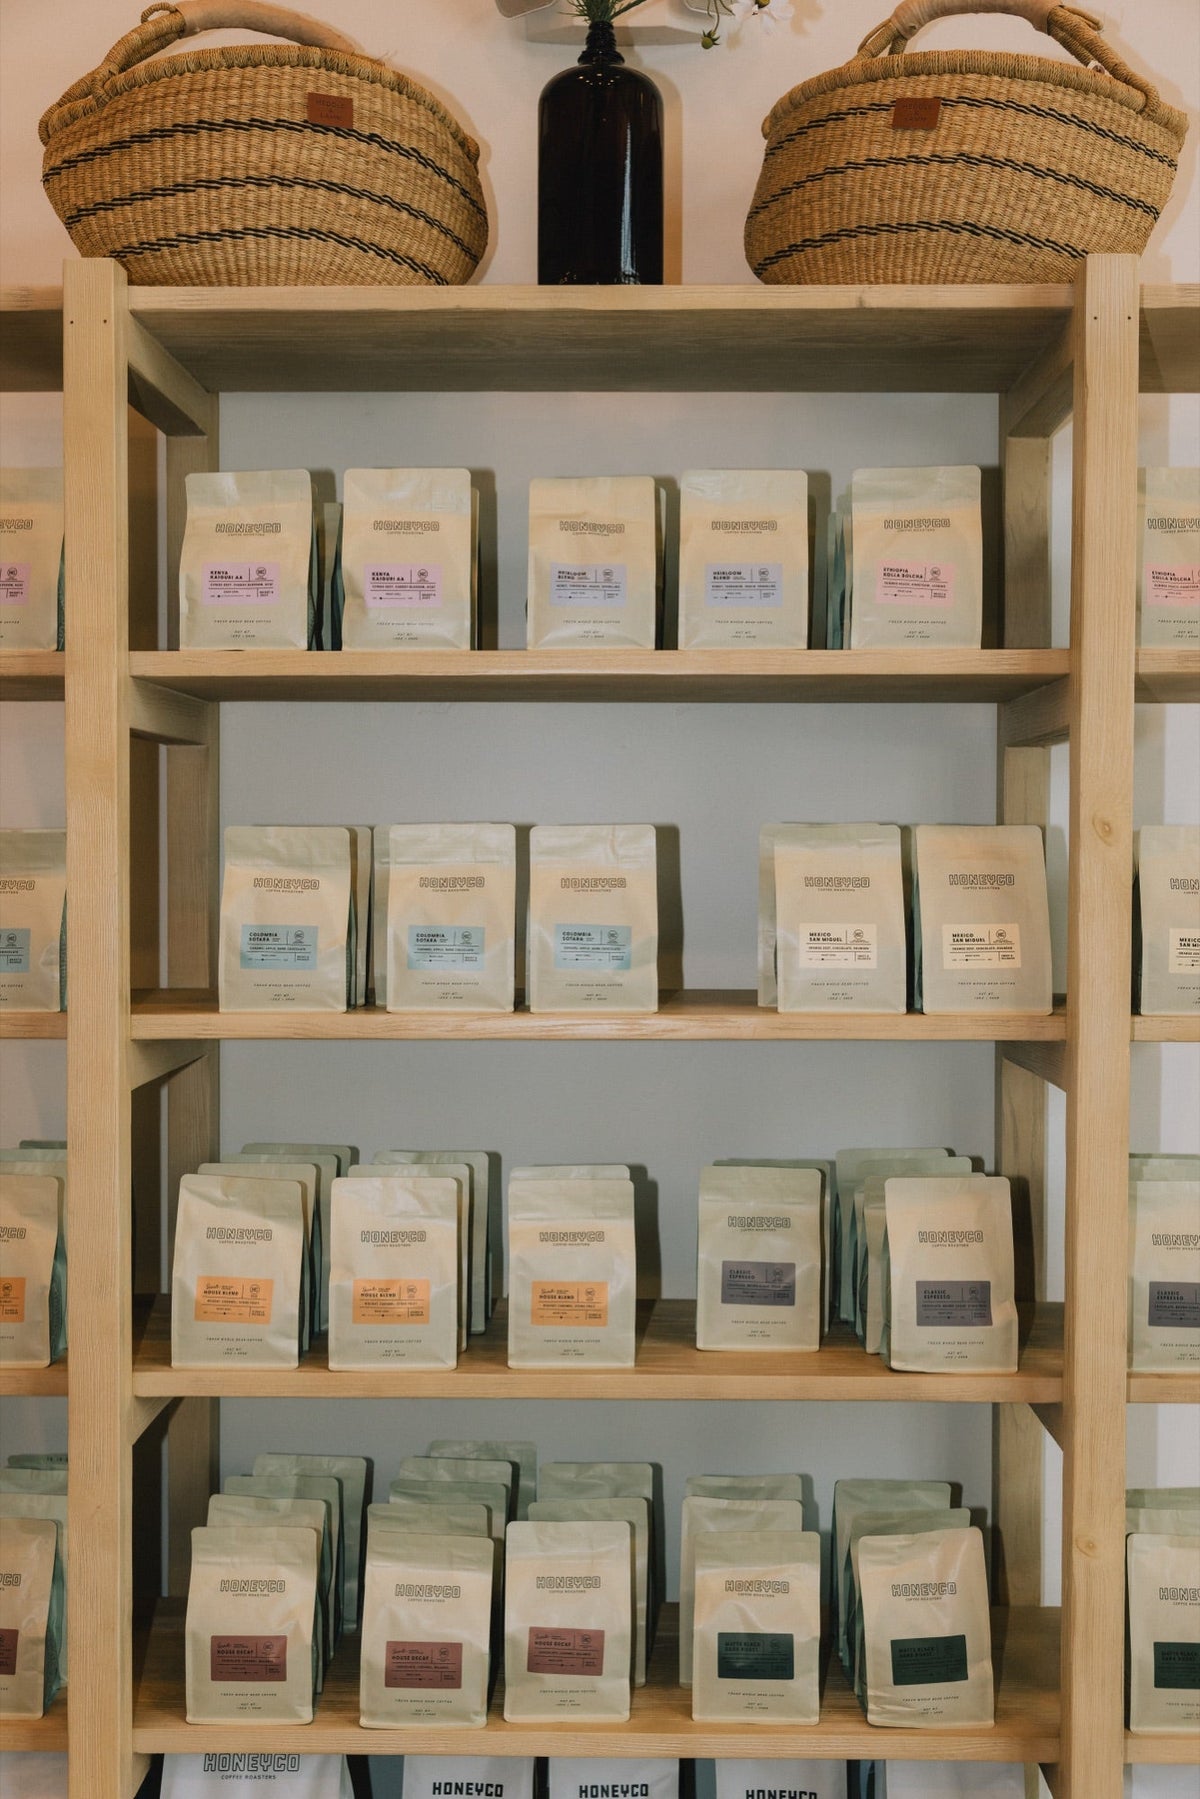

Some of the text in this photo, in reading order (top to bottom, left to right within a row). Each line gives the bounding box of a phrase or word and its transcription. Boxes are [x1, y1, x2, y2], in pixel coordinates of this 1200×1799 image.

[0, 519, 33, 530] EYCO
[215, 522, 281, 533] HONEYCO
[373, 520, 440, 531] HONEYCO
[711, 520, 778, 531] HONEYCO
[883, 518, 951, 529] HONEYCO
[1147, 518, 1200, 529] HONEY
[0, 879, 36, 891] EYCO
[253, 878, 319, 890] HONEYCO
[419, 876, 485, 888] HONEYCO
[560, 877, 626, 888] HONEYCO
[804, 876, 870, 888] HONEYCO
[948, 874, 1014, 885] HONEYCO
[727, 1216, 791, 1228] HONEYCO
[206, 1227, 272, 1241] HONEYCO
[360, 1230, 427, 1242] HONEYCO
[539, 1230, 604, 1242] HONEYCO
[918, 1230, 984, 1243] HONEYCO
[1152, 1233, 1200, 1246] HONEY
[220, 1579, 285, 1592] HONEYCO
[536, 1576, 601, 1589] HONEYCO
[725, 1580, 789, 1593] HONEYCO
[395, 1584, 461, 1598] HONEYCO
[891, 1582, 957, 1597] HONEYCO
[1159, 1587, 1200, 1600] HONE
[203, 1753, 300, 1772] HONEYCO
[432, 1782, 504, 1797] HONEYCO
[579, 1783, 649, 1798] HONEYCO
